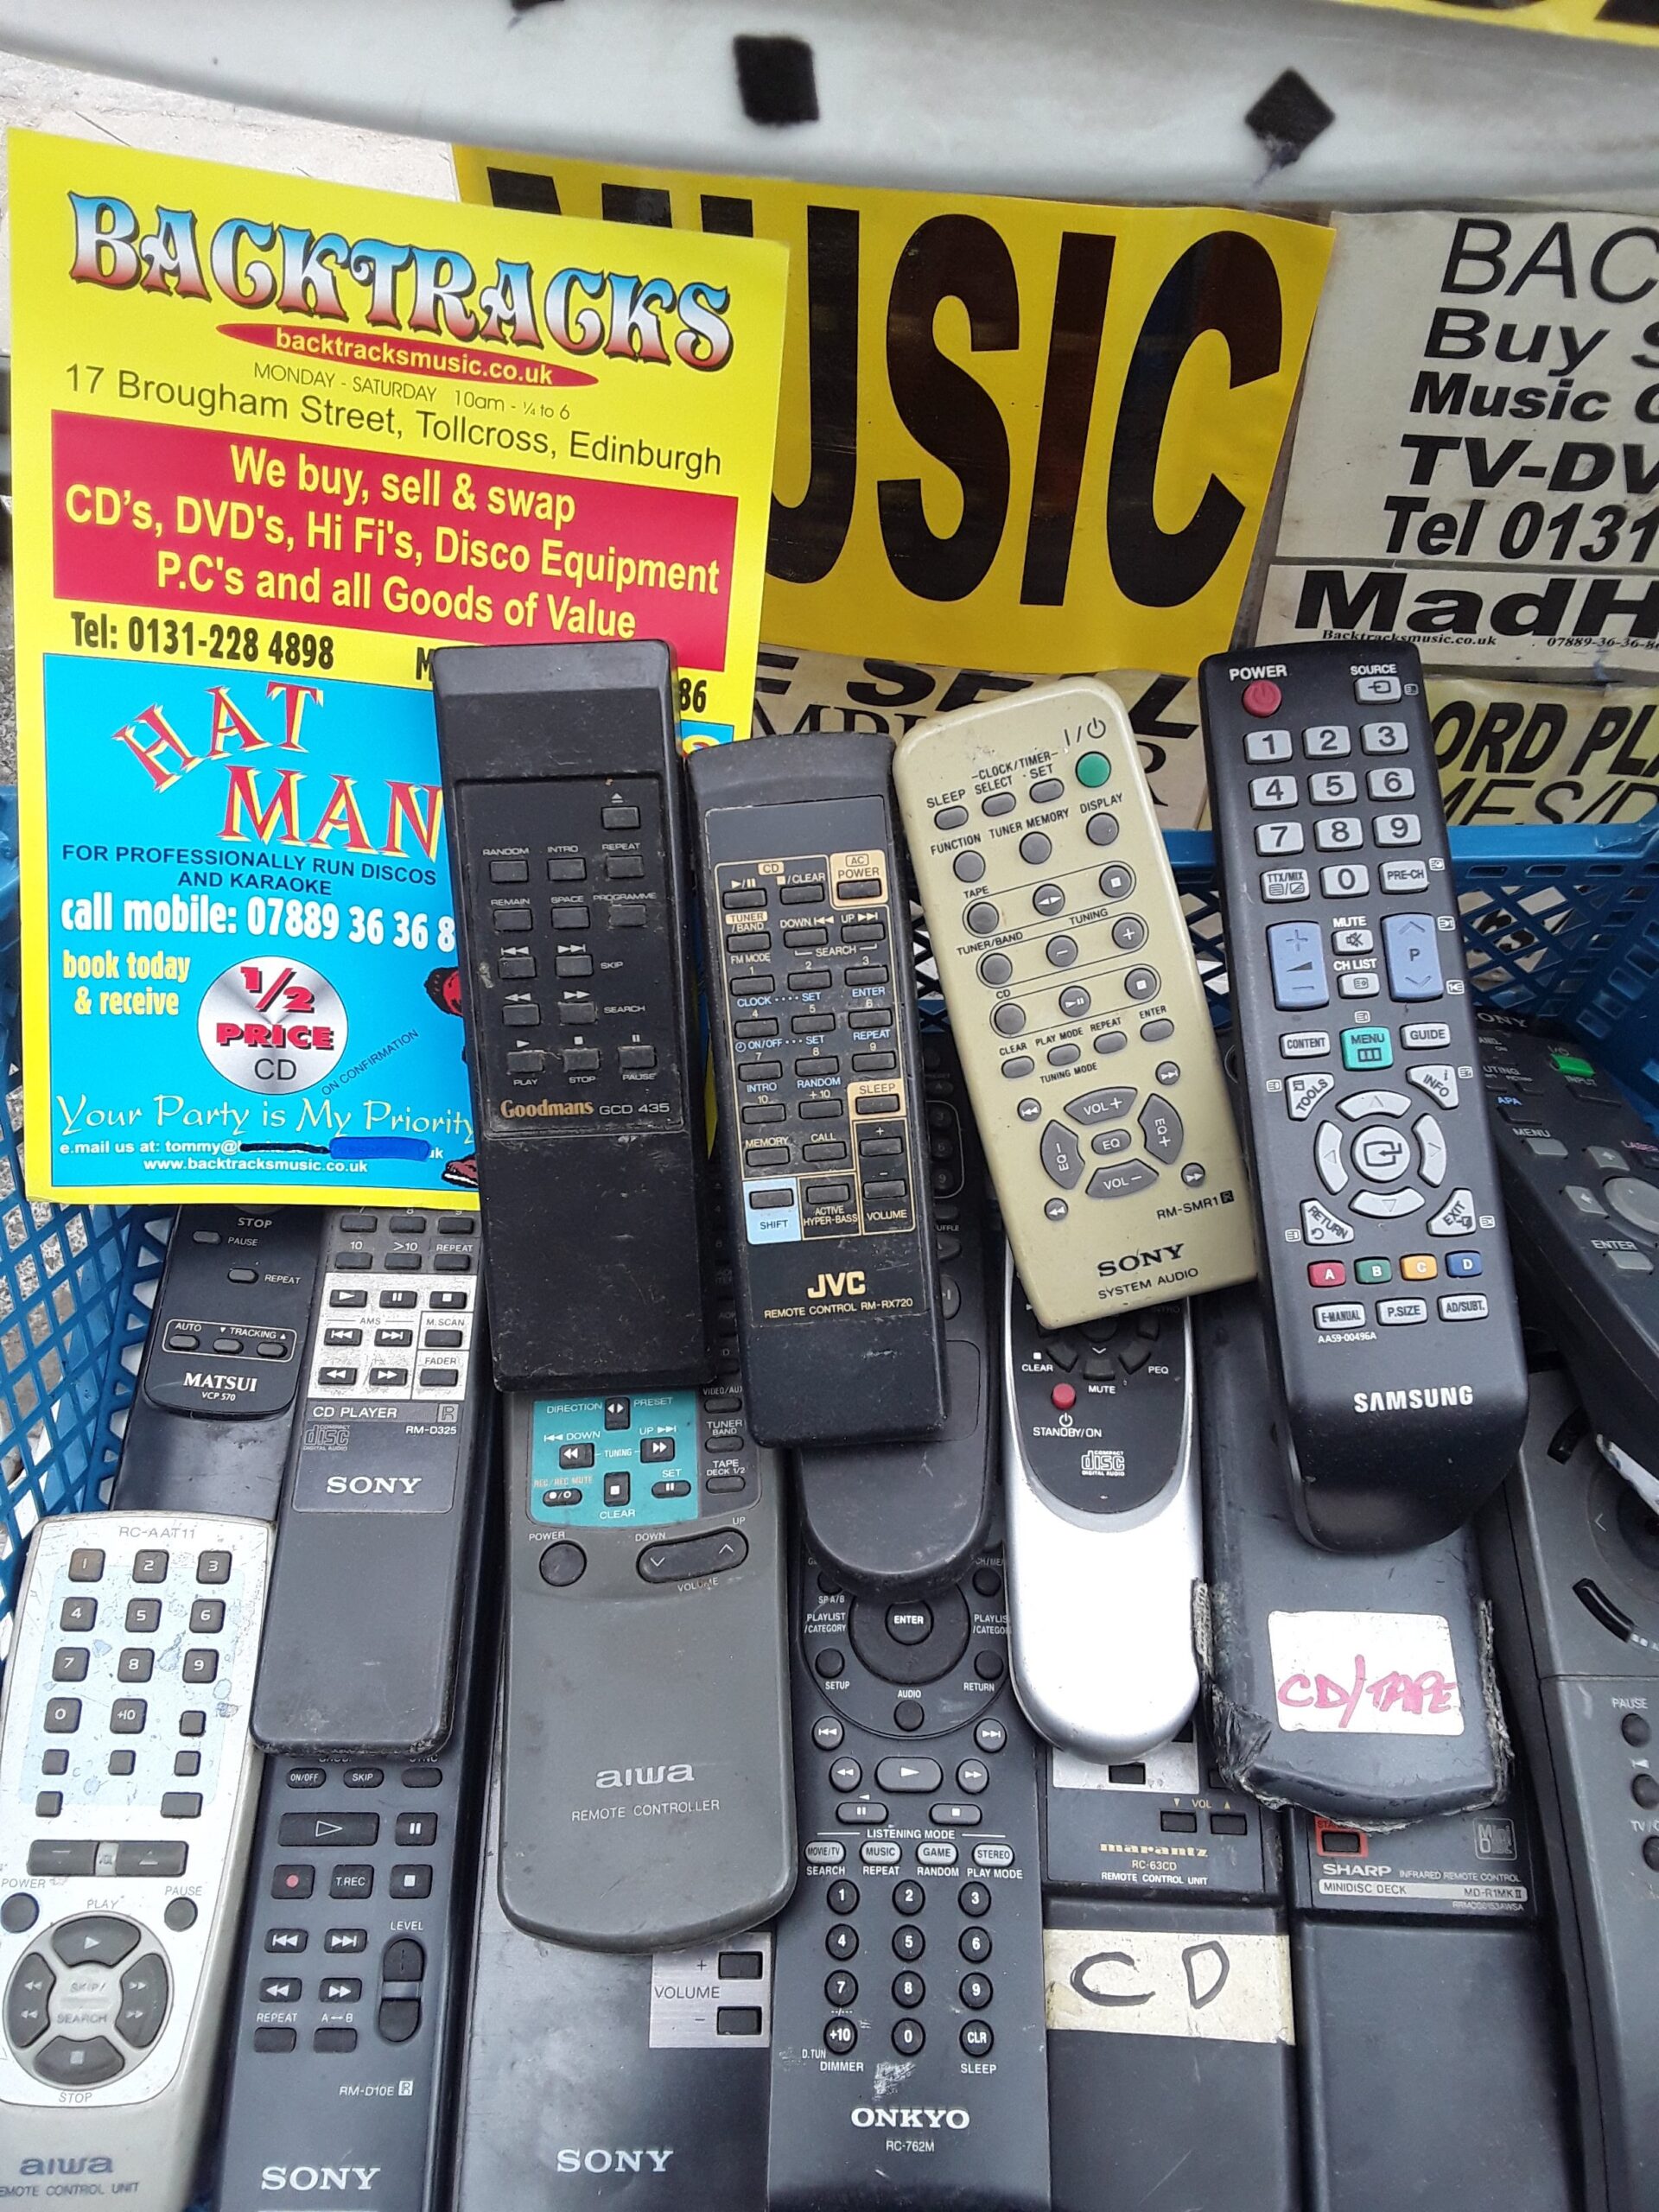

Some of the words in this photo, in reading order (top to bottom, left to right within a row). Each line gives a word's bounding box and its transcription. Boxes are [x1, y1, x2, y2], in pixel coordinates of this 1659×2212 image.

[67, 191, 734, 372] BACKTRACKS
[1423, 308, 1609, 377] Buy
[275, 326, 554, 386] backtracksmusic.co.uk
[254, 362, 335, 388] MONDAY
[353, 377, 437, 403] SATURDAY
[454, 390, 505, 412] 10am
[540, 404, 554, 419] to
[560, 404, 570, 420] 6
[1409, 371, 1611, 423] Music
[65, 363, 105, 396] 17
[118, 371, 289, 423] Brougham
[301, 394, 404, 439] Street,
[416, 410, 557, 461] Tollcross,
[569, 430, 722, 478] Edinburgh
[230, 444, 286, 489] We
[298, 454, 369, 507] buy,
[381, 464, 441, 504] sell
[452, 476, 477, 509] &
[487, 487, 576, 528] swap
[1383, 495, 1485, 556] Tel
[1499, 503, 1659, 563] 0131
[175, 495, 294, 553] DVD's,
[307, 511, 343, 553] Hi
[354, 518, 423, 569] Fi's,
[435, 526, 530, 575] Disco
[540, 538, 721, 598] Equipment
[156, 550, 244, 598] P.C's
[256, 565, 315, 606] and
[333, 569, 372, 609] all
[382, 576, 489, 626] Goods
[503, 587, 538, 630] of
[547, 593, 637, 639] Value
[71, 612, 118, 649] Tel:
[127, 616, 258, 661] 0131-228
[268, 626, 334, 671] 4898
[1229, 664, 1287, 681] POWER
[1351, 664, 1396, 676] SOURCE
[111, 680, 324, 792] HAT
[926, 789, 966, 809] SLEEP
[1079, 793, 1122, 814] DISPLAY
[216, 764, 445, 863] MAN
[482, 847, 530, 857] RANDOM
[601, 842, 641, 852] REPEAT
[931, 833, 982, 855] FUNCTION
[61, 844, 110, 862] FOR
[115, 846, 306, 873] PROFESSIONALLY
[312, 855, 356, 876] RUN
[360, 862, 437, 887] DISCOS
[837, 867, 880, 878] POWER
[177, 869, 224, 889] AND
[230, 872, 333, 897] KARAOKE
[963, 886, 989, 899] TAPE
[60, 892, 111, 932] call
[124, 895, 237, 936] mobile:
[247, 902, 340, 940] 07889
[348, 908, 384, 946] 36
[393, 912, 429, 947] 36
[1069, 908, 1109, 925] TUNING
[1332, 917, 1367, 928] MUTE
[957, 931, 1023, 957] TUNER/BAND
[63, 950, 119, 980] book
[125, 951, 190, 984] today
[240, 966, 320, 1016] 1/2
[74, 988, 92, 1014] &
[99, 986, 180, 1016] receive
[603, 1004, 645, 1014] SEARCH
[215, 1022, 335, 1052] PRICE
[1287, 1037, 1325, 1049] CONTENT
[1351, 1033, 1385, 1046] MENU
[1409, 1028, 1446, 1041] GUIDE
[254, 1058, 297, 1083] CD
[321, 1080, 340, 1096] ON
[340, 1029, 419, 1084] CONFIRMATION
[797, 1077, 841, 1088] RANDOM
[859, 1083, 896, 1095] SLEEP
[500, 1098, 594, 1119] Goodmans
[599, 1103, 634, 1116] GCD
[638, 1102, 670, 1114] 435
[56, 1094, 143, 1135] Your
[153, 1095, 250, 1136] Party
[262, 1100, 286, 1128] is
[296, 1098, 351, 1137] My
[364, 1100, 474, 1145] Priority
[60, 1140, 110, 1154] e.mail
[114, 1143, 134, 1153] us
[139, 1141, 161, 1153] at:
[144, 1156, 368, 1173] www.backtracksmusic.co.uk
[866, 1210, 907, 1222] VOLUME
[1157, 1196, 1218, 1220] RM-SMR1
[1591, 1239, 1637, 1251] ENTER
[1097, 1243, 1185, 1278] SONY
[264, 1274, 302, 1285] REPEAT
[807, 1270, 866, 1299] JVC
[1098, 1278, 1152, 1300] SYSTEM
[1157, 1268, 1198, 1286] AUDIO
[764, 1306, 805, 1319] REMOTE
[809, 1303, 857, 1315] CONTROL
[861, 1298, 913, 1310] RM-RX720
[1321, 1310, 1361, 1323] E-MANUAL
[1387, 1305, 1421, 1318] P.SIZE
[175, 1322, 202, 1332] AUTO
[230, 1327, 276, 1339] TRACKING
[1318, 1332, 1377, 1344] AA59-00496A
[183, 1372, 257, 1393] MATSUI
[1088, 1385, 1116, 1394] MUTE
[201, 1392, 219, 1401] VCP
[220, 1393, 236, 1402] 570
[1354, 1385, 1473, 1414] SAMSUNG
[312, 1407, 334, 1419] CD
[340, 1407, 397, 1419] PLAYER
[546, 1402, 603, 1414] DIRECTION
[405, 1425, 457, 1435] RM-D325
[1033, 1427, 1102, 1438] STANDBY/ON
[327, 1476, 422, 1494] SONY
[118, 1527, 196, 1539] RC-AAT11
[529, 1531, 565, 1541] POWER
[893, 1615, 924, 1624] ENTER
[1278, 1655, 1458, 1728] CD/TAPE
[595, 1763, 696, 1789] aiwa
[571, 1807, 626, 1822] REMOTE
[633, 1800, 721, 1816] CONTROLLER
[867, 1829, 921, 1839] LISTENING
[925, 1829, 956, 1840] MODE
[1099, 1843, 1208, 1858] marantz
[1132, 1859, 1177, 1871] RC-63CD
[1323, 1864, 1392, 1877] SHARP
[1101, 1872, 1138, 1882] REMOTE
[1142, 1874, 1184, 1885] CONTROL
[1187, 1876, 1208, 1885] UNIT
[1324, 1881, 1372, 1893] MINIDISC
[1376, 1884, 1407, 1894] DECK
[390, 1920, 424, 1931] LEVEL
[654, 1986, 721, 1999] VOLUME
[820, 2061, 864, 2072] DIMMER
[960, 2063, 997, 2075] SLEEP
[339, 2084, 395, 2098] RM-D10E
[850, 2107, 970, 2130] ONKYO
[886, 2140, 935, 2152] RC-762M
[19, 2156, 113, 2177] aiwa
[556, 2149, 674, 2173] SONY
[261, 2166, 380, 2191] SONY
[45, 2183, 105, 2196] CONTROL
[111, 2181, 139, 2194] UNIT
